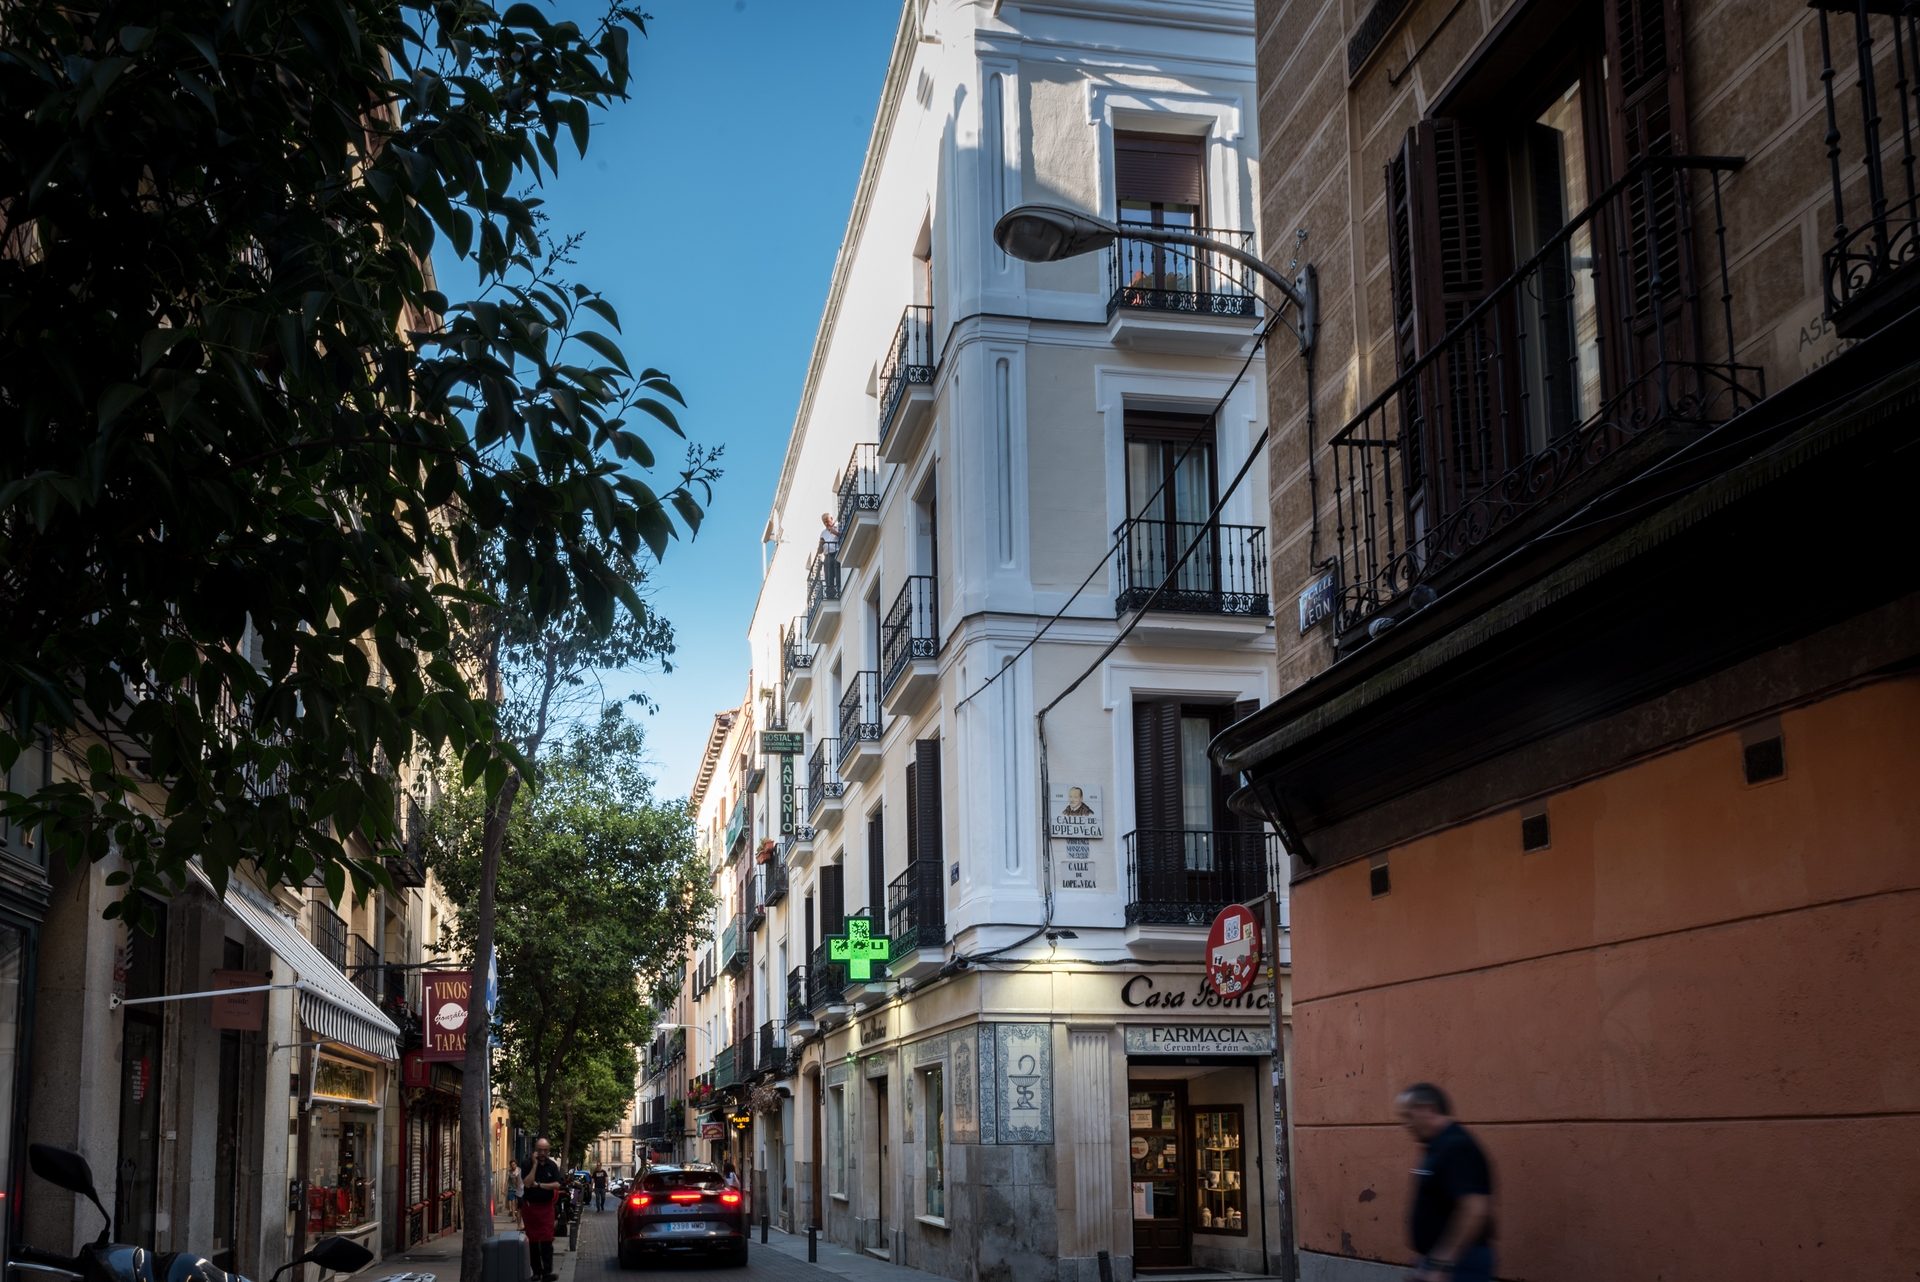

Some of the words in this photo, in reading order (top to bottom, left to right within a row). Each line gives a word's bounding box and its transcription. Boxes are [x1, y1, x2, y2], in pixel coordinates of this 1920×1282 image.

[1308, 576, 1333, 600] CALLE
[763, 734, 791, 742] HOSTAL
[782, 765, 793, 832] ANTONIO
[1056, 816, 1085, 824] CALLE
[1052, 824, 1073, 836] LOPE
[1079, 825, 1102, 836] VEGA
[1068, 862, 1088, 871] CALLE
[1062, 880, 1077, 888] LOPE
[1080, 880, 1096, 888] VEGA
[434, 981, 467, 999] VINOS
[1121, 975, 1185, 1009] Casa
[1152, 1028, 1249, 1042] FARMACIA
[434, 1033, 466, 1051] TAPAS
[1163, 1043, 1211, 1052] Cervantes
[1215, 1042, 1239, 1052] León
